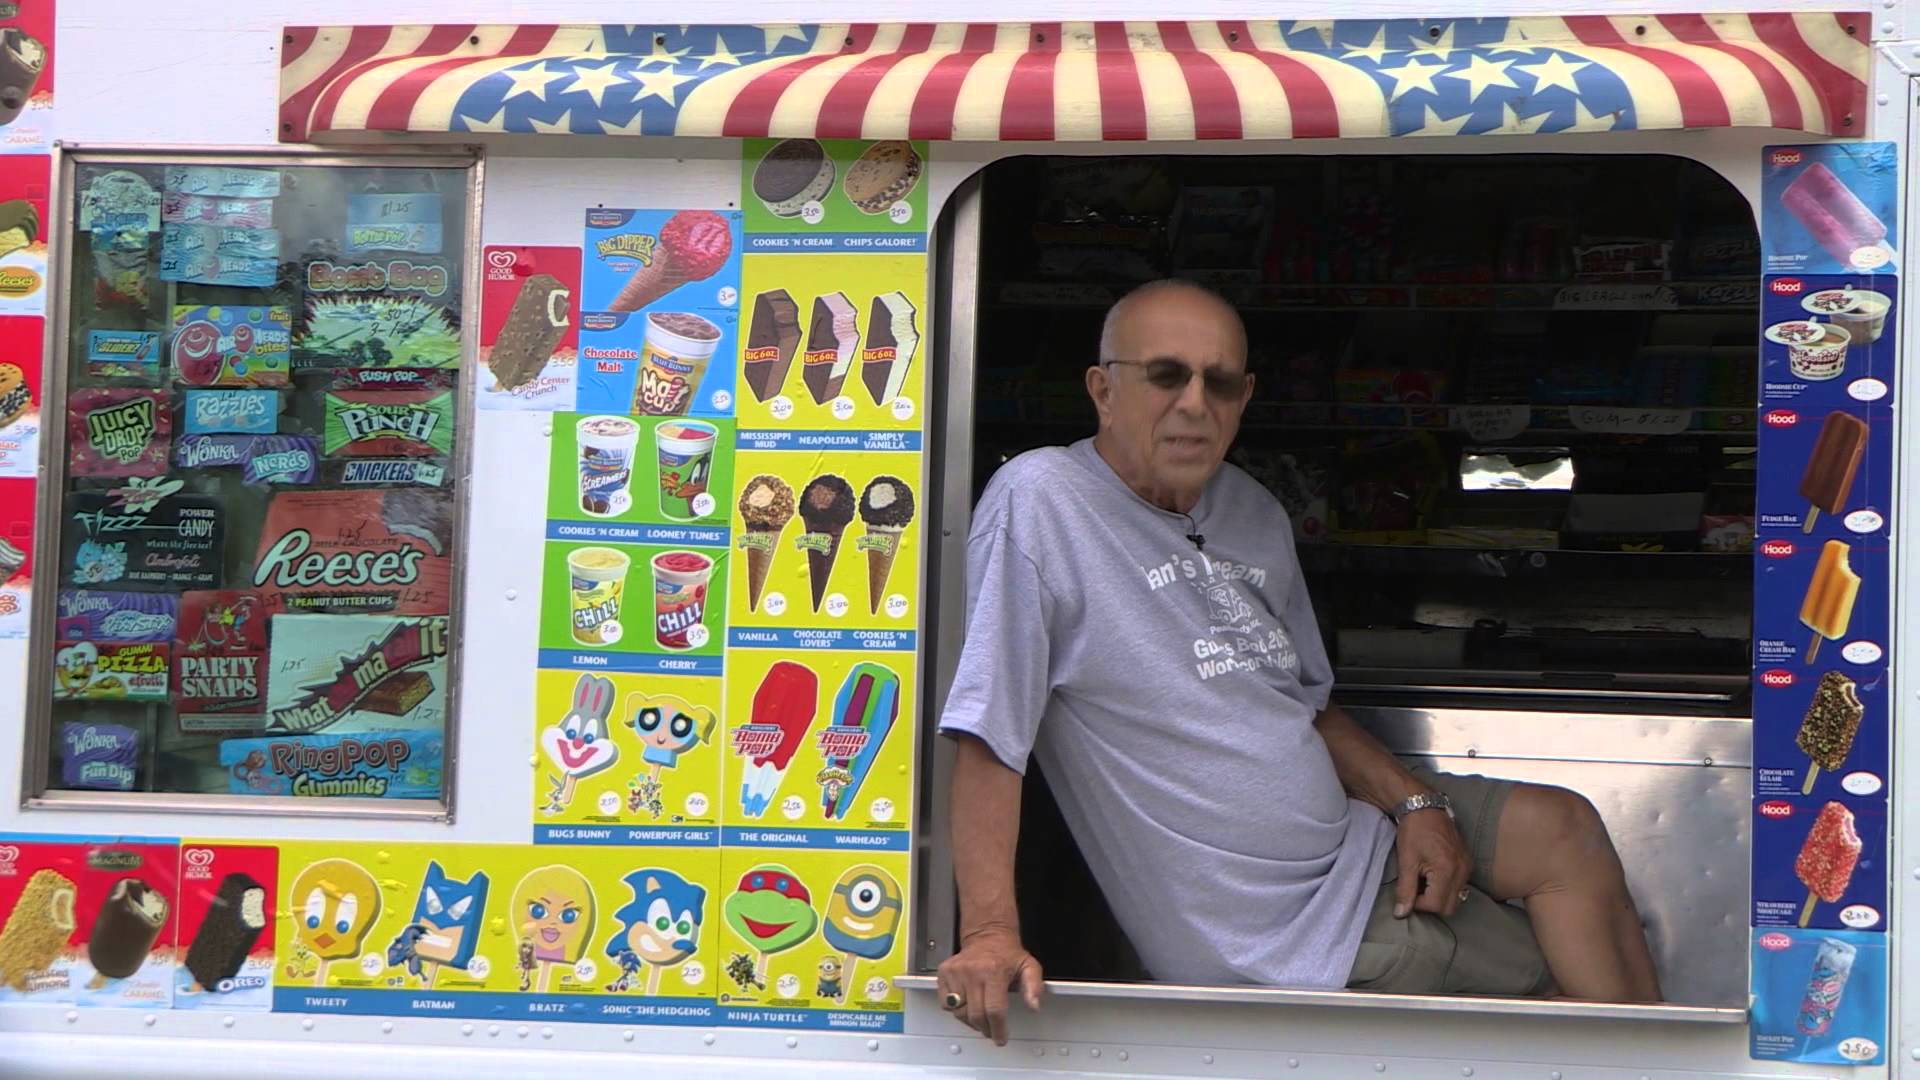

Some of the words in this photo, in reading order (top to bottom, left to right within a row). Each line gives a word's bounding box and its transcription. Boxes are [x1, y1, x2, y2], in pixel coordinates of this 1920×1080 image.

[1773, 153, 1801, 164] Hood
[617, 233, 656, 255] DIPPER
[753, 239, 789, 247] COOKIES
[802, 239, 833, 247] CREAM
[844, 239, 872, 247] CHIPS
[874, 239, 917, 247] GALORE!
[388, 261, 447, 297] Bag
[1773, 281, 1801, 293] Hood
[255, 342, 288, 355] bites
[584, 348, 638, 359] Chocolate
[746, 352, 759, 360] BIG
[805, 353, 819, 363] BIG
[864, 351, 878, 360] BIG
[597, 362, 624, 372] Malt
[359, 371, 392, 383] PUSH
[394, 371, 419, 382] POP
[512, 381, 541, 397] Candy
[541, 376, 571, 386] Center
[524, 385, 557, 400] Crunch
[367, 405, 410, 416] SOUR
[89, 400, 154, 443] JUICY
[1769, 414, 1796, 424] Hood
[337, 408, 441, 442] PUNCH
[103, 424, 147, 455] DROP
[740, 433, 791, 441] MISSISSIPPI
[799, 437, 858, 445] NEAPOLITAN
[868, 433, 904, 441] SIMPLY
[755, 441, 777, 449] MUD
[864, 441, 906, 449] VANILLA
[120, 446, 142, 464] POP
[344, 461, 419, 482] SNICKERS
[179, 508, 215, 518] POWER
[178, 519, 215, 538] CANDY
[559, 527, 596, 536] COOKIES
[609, 528, 639, 537] CREAM
[648, 529, 687, 539] LOONEY
[690, 531, 721, 541] TUNES
[1765, 544, 1792, 554] Hood
[252, 527, 426, 588] Reese's
[296, 597, 330, 607] PEANUT
[333, 597, 366, 606] BUTTER
[369, 596, 393, 605] CUPS
[657, 602, 702, 633] CHILL
[738, 632, 778, 640] VANILLA
[794, 631, 842, 639] CHOCOLATE
[853, 631, 894, 640] COOKIES
[864, 639, 896, 648] CREAM
[119, 644, 153, 657] GUMMI
[98, 656, 167, 673] PIZZA
[573, 655, 608, 665] LEMON
[659, 660, 697, 669] CHERRY
[181, 657, 259, 677] PARTY
[1765, 674, 1792, 684] Hood
[181, 677, 258, 698] SNAPS
[276, 696, 336, 731] What
[736, 730, 783, 742] BOMB
[821, 732, 868, 745] BOMB
[739, 743, 773, 755] POP
[825, 744, 860, 757] POP
[81, 763, 109, 778] Fun
[110, 764, 133, 784] Dip
[292, 771, 388, 797] Gummies
[1762, 805, 1790, 815] Hood
[548, 829, 575, 838] BUGS
[577, 829, 611, 839] BUNNY
[629, 830, 682, 840] POWERPUFF
[684, 831, 710, 840] GIRLS
[739, 832, 758, 841] THE
[761, 833, 808, 843] ORIGINAL
[836, 835, 888, 845] WARHEADS
[218, 976, 265, 993] OREO
[305, 997, 348, 1007] TWEETY
[412, 1000, 456, 1010] BATMAN
[529, 1003, 564, 1013] BRATZ
[603, 1005, 633, 1014] SONIC
[657, 1006, 711, 1017] HEDGEHOG
[728, 1012, 762, 1023] NINJA
[764, 1012, 804, 1023] TURTLE
[828, 1012, 872, 1021] DESPICABLE
[875, 1014, 887, 1022] ME
